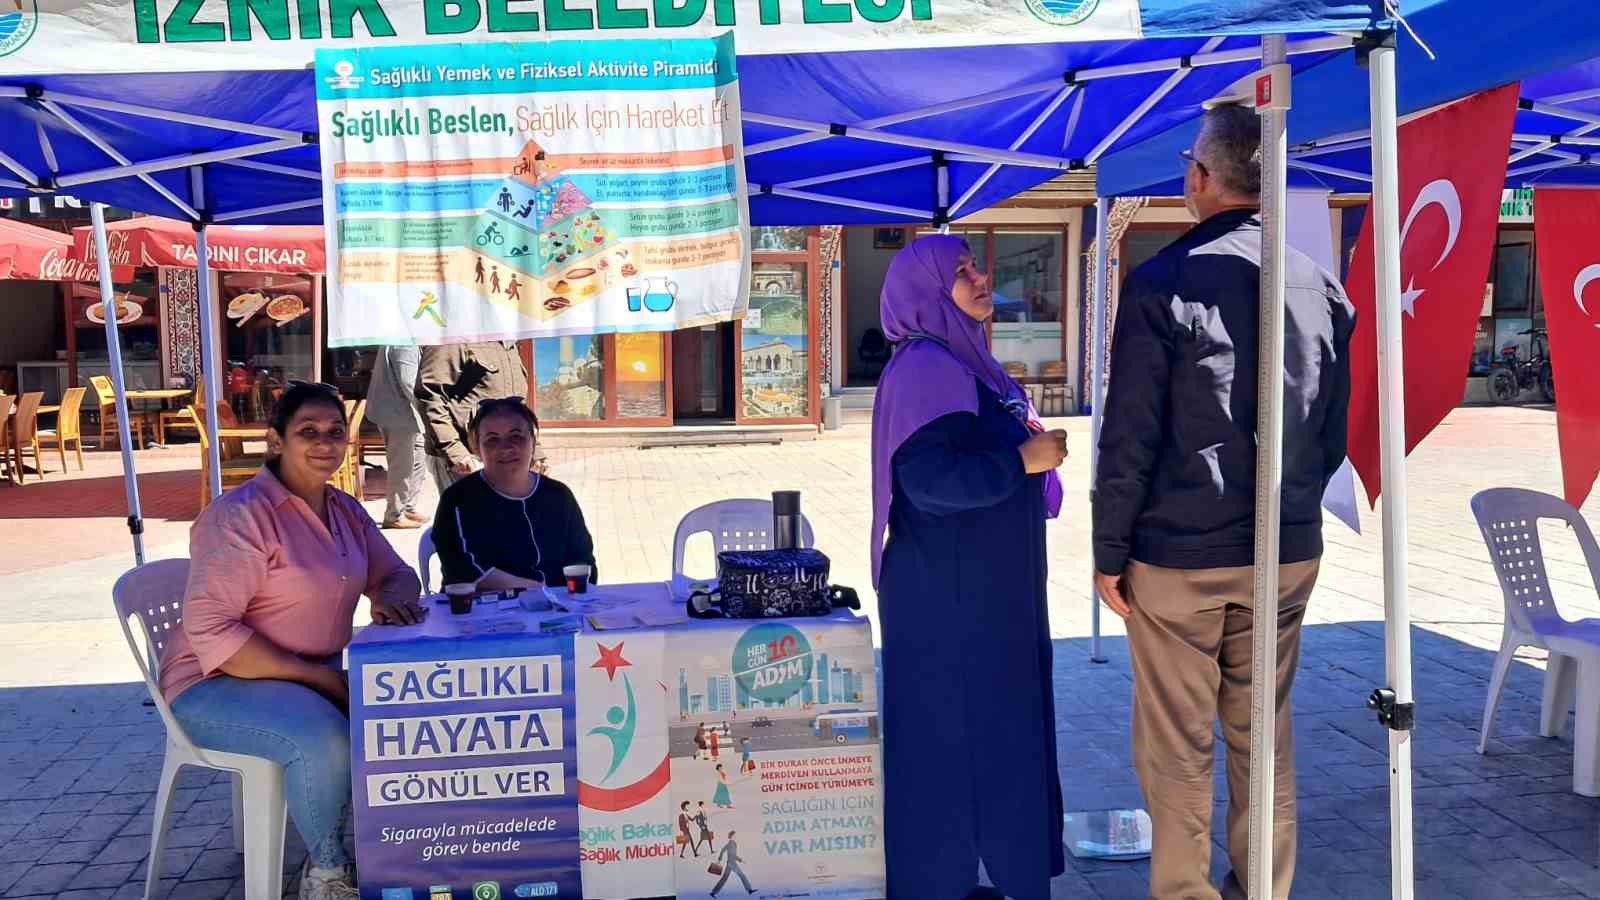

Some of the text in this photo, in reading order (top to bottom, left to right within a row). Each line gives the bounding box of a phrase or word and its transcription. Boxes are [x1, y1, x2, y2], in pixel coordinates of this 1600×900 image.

[371, 65, 431, 87] Sağlıklı
[437, 64, 492, 81] Yemek
[497, 65, 515, 79] ve
[520, 60, 582, 79] Fiziksel
[588, 59, 649, 77] Aktivite
[653, 57, 719, 77] Piramidi
[332, 109, 420, 143] Sağlıklı
[428, 106, 514, 136] Beslen,
[516, 103, 578, 136] Sağlık
[626, 100, 706, 130] Hareket
[711, 96, 730, 126] Et
[244, 246, 307, 266] ÇIKAR
[747, 643, 767, 658] HER
[375, 662, 550, 702] SAĞLIKLI
[376, 713, 551, 757] HAYATA
[380, 770, 551, 802] GÖNÜL VER
[381, 816, 557, 845] Sigarayla mücadelede
[762, 816, 874, 834] ADIM ATMAYA
[423, 838, 521, 861] görev bende
[765, 836, 877, 855] VAR MISIN?
